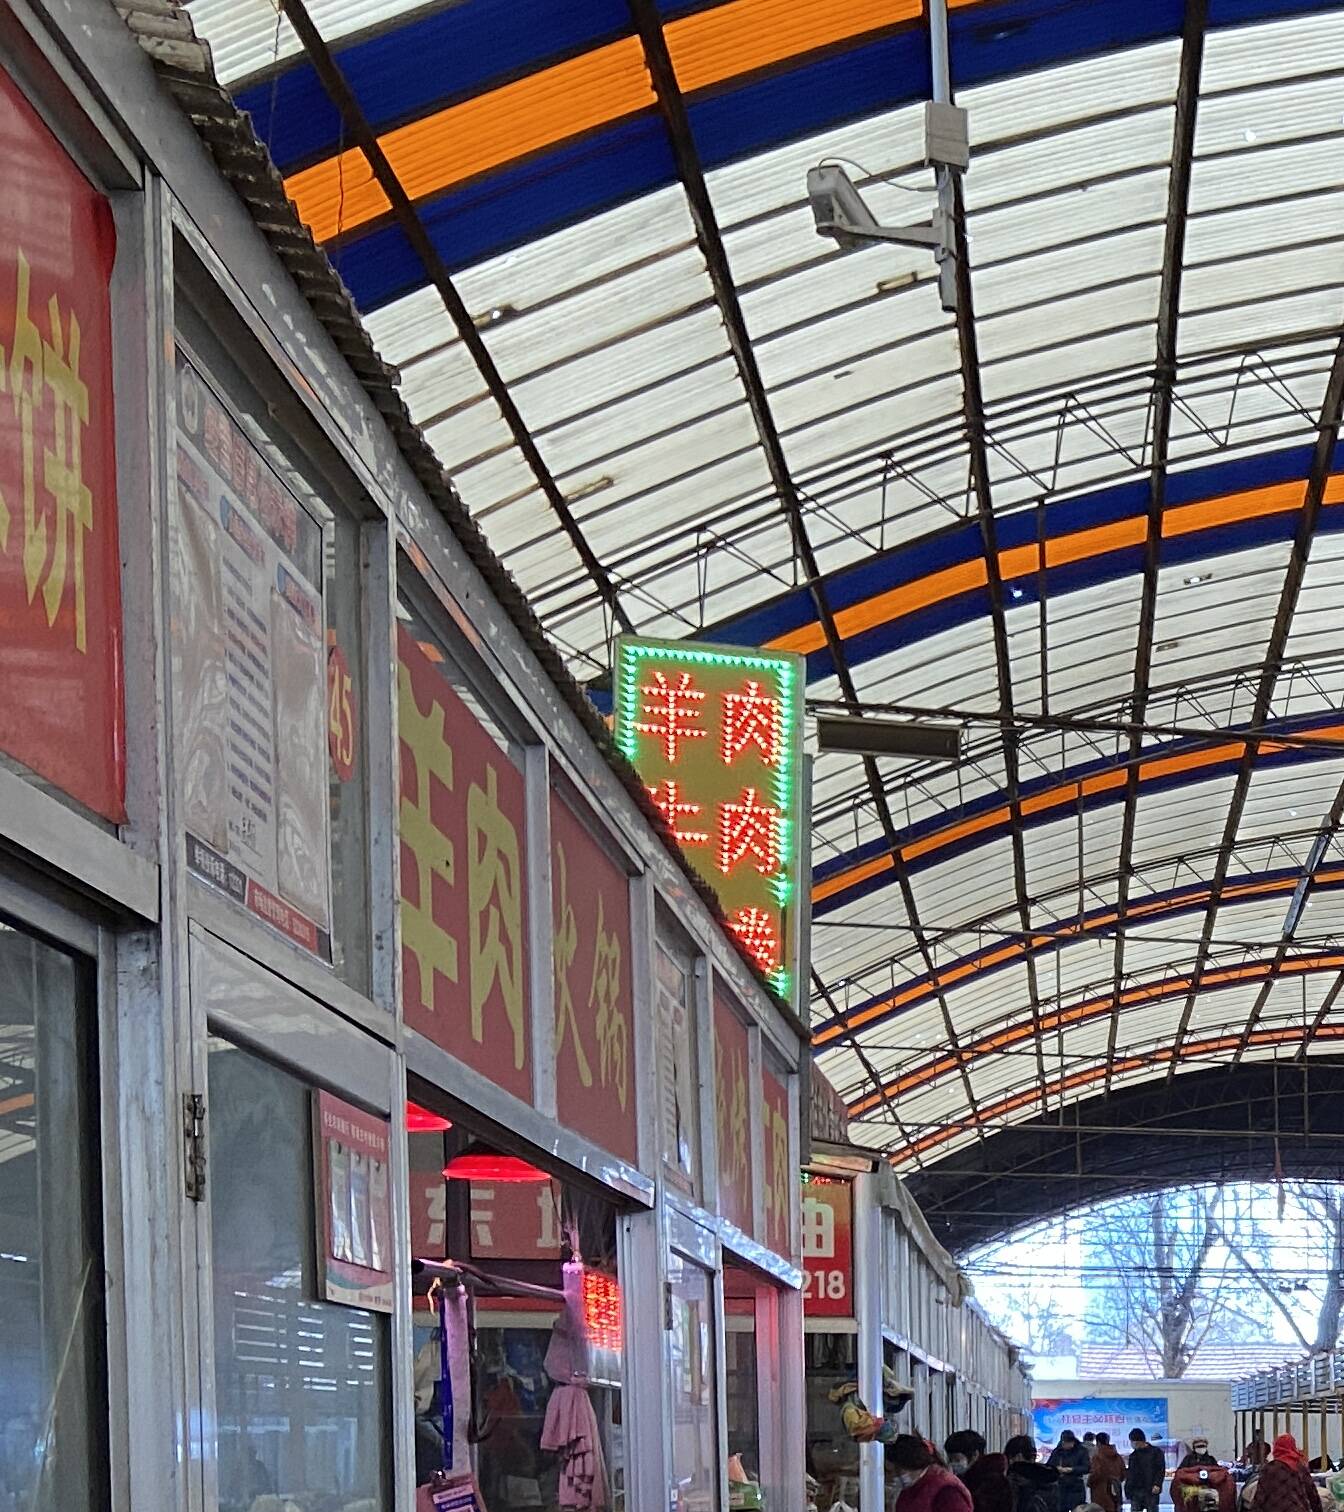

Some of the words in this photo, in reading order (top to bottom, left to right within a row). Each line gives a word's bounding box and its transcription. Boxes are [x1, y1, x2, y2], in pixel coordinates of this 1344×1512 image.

[0, 246, 93, 655] 饼
[633, 671, 787, 767] 羊肉
[762, 1096, 789, 1248] 肉
